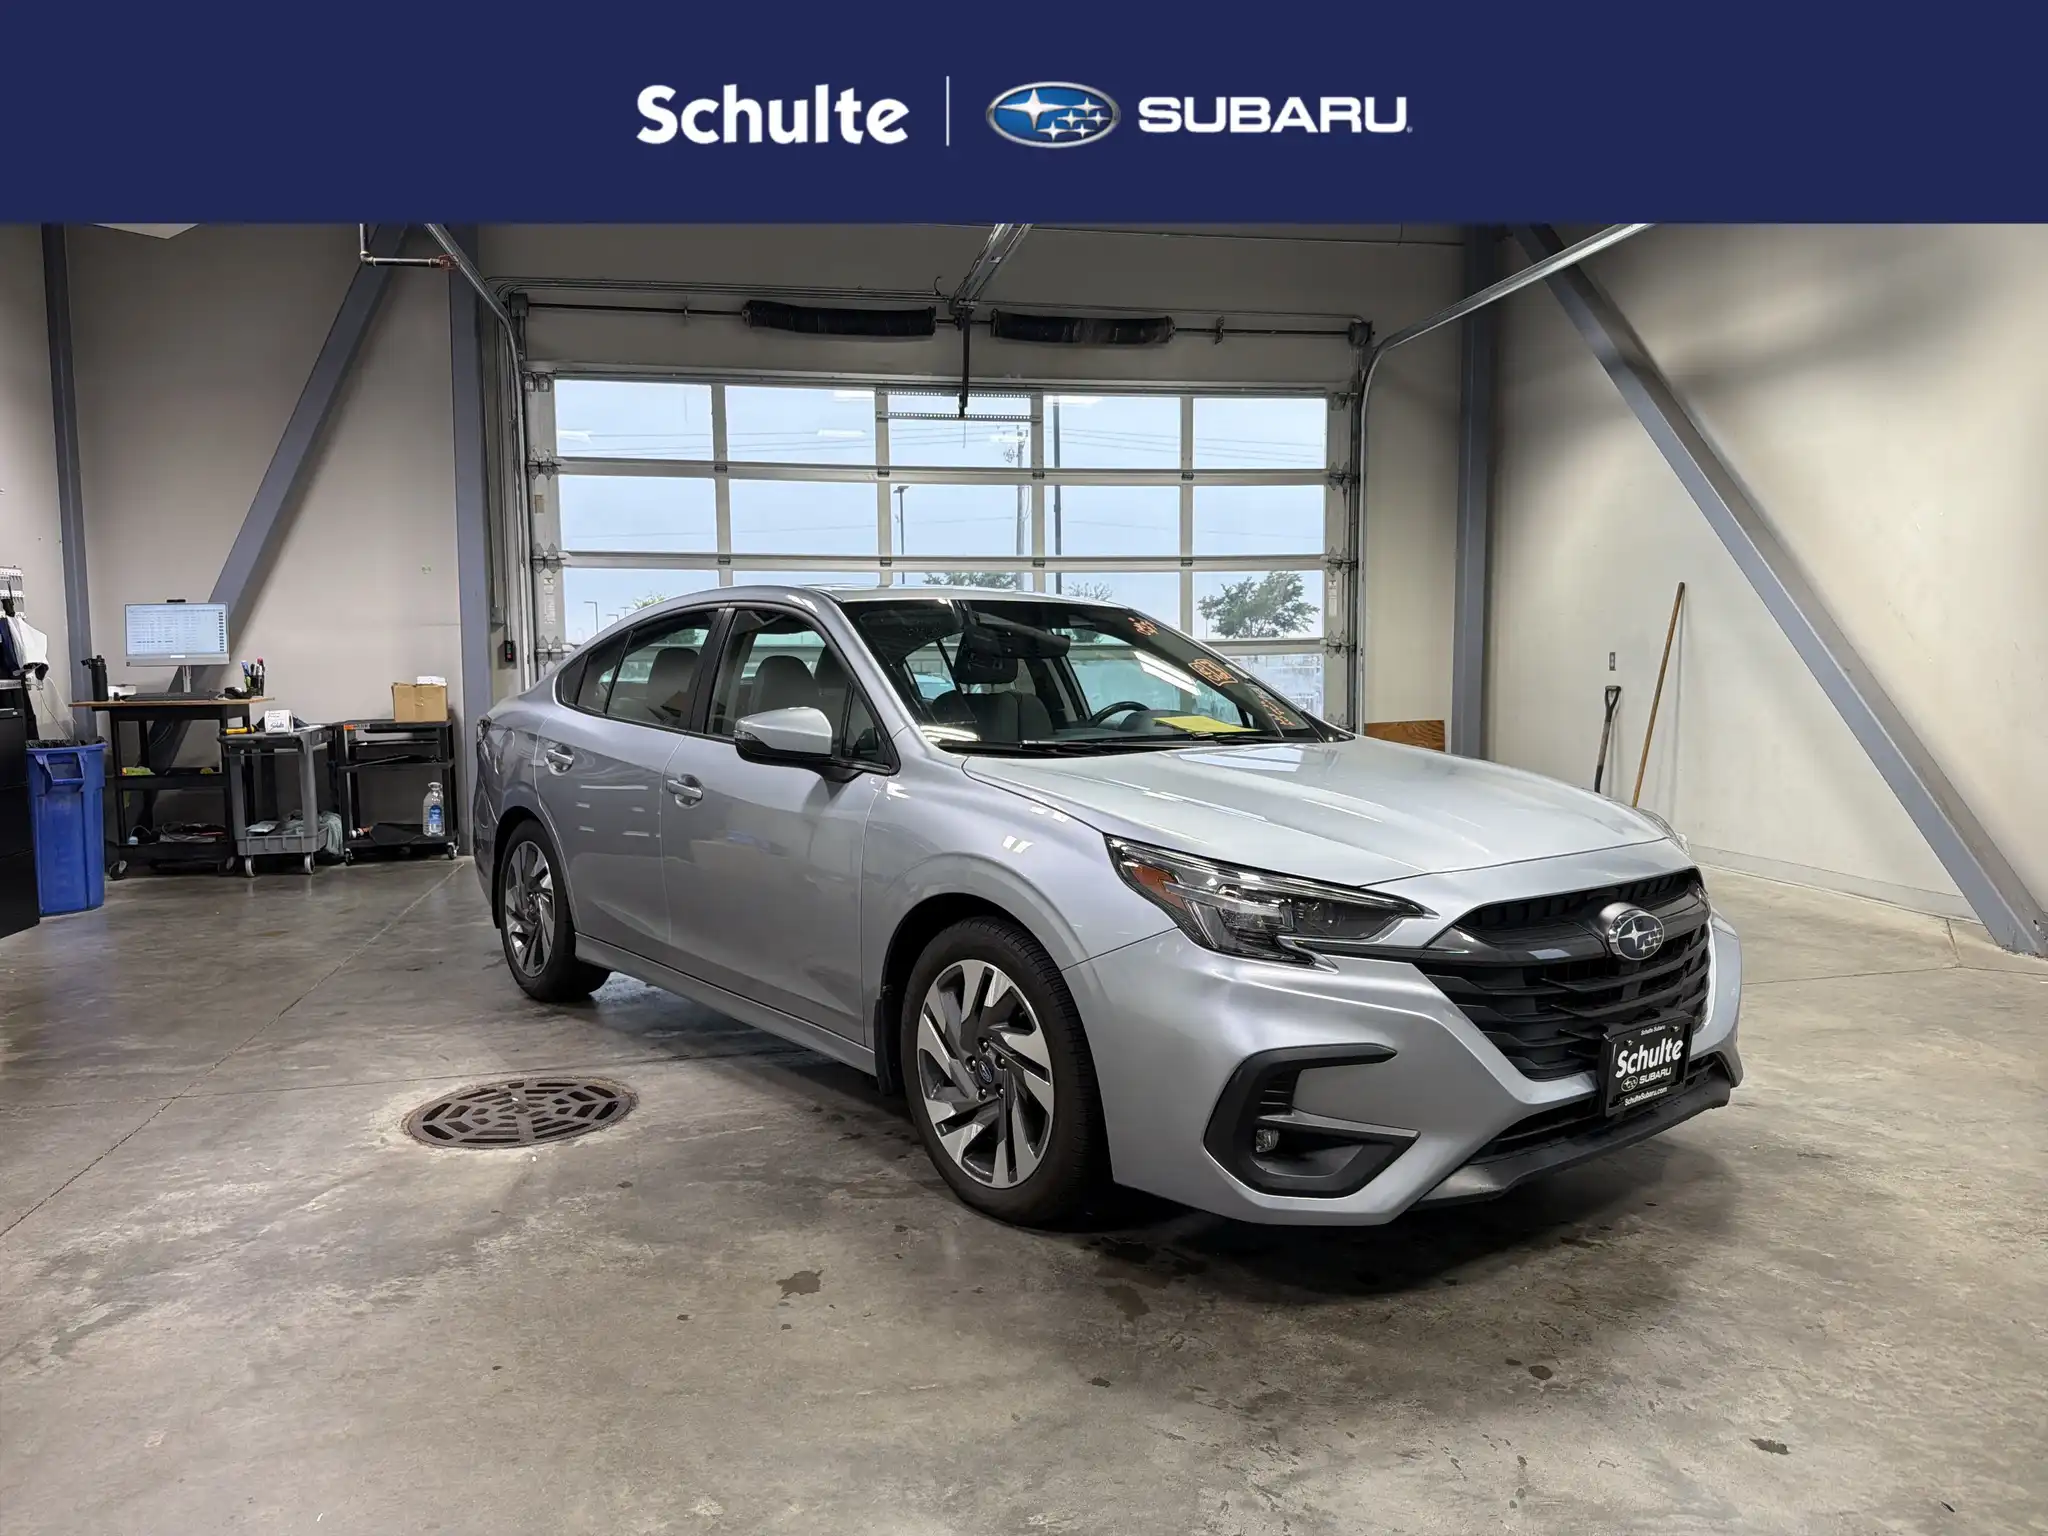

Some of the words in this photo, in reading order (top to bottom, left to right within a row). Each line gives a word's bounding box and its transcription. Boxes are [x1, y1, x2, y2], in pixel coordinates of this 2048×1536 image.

[1615, 1037, 1683, 1078] Schulte
[1639, 1067, 1672, 1084] SUBARU
[1624, 1086, 1668, 1106] SchulteSubaru.com
